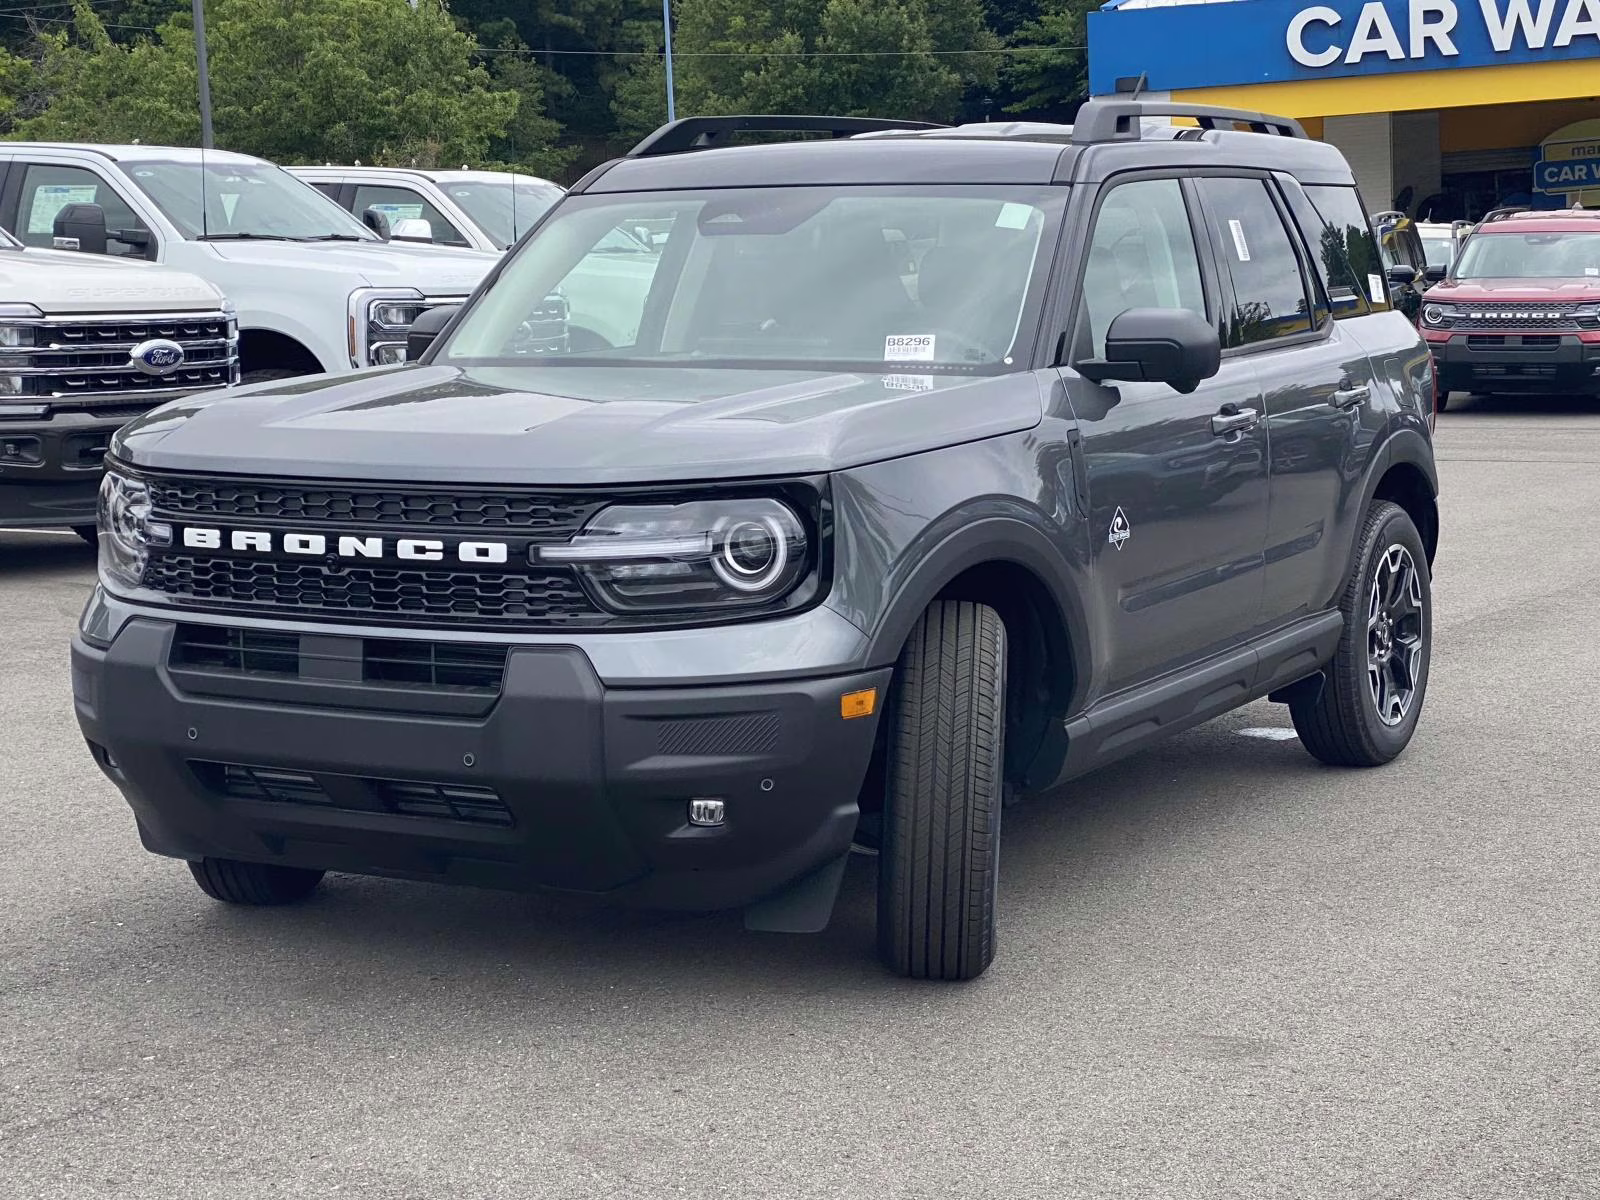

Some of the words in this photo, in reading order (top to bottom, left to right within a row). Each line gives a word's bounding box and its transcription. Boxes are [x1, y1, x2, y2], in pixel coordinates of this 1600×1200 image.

[1286, 0, 1460, 67] CAR
[1544, 165, 1587, 182] CAR
[888, 337, 931, 346] B8296
[151, 349, 175, 365] Ford
[184, 527, 508, 563] BRONCO
